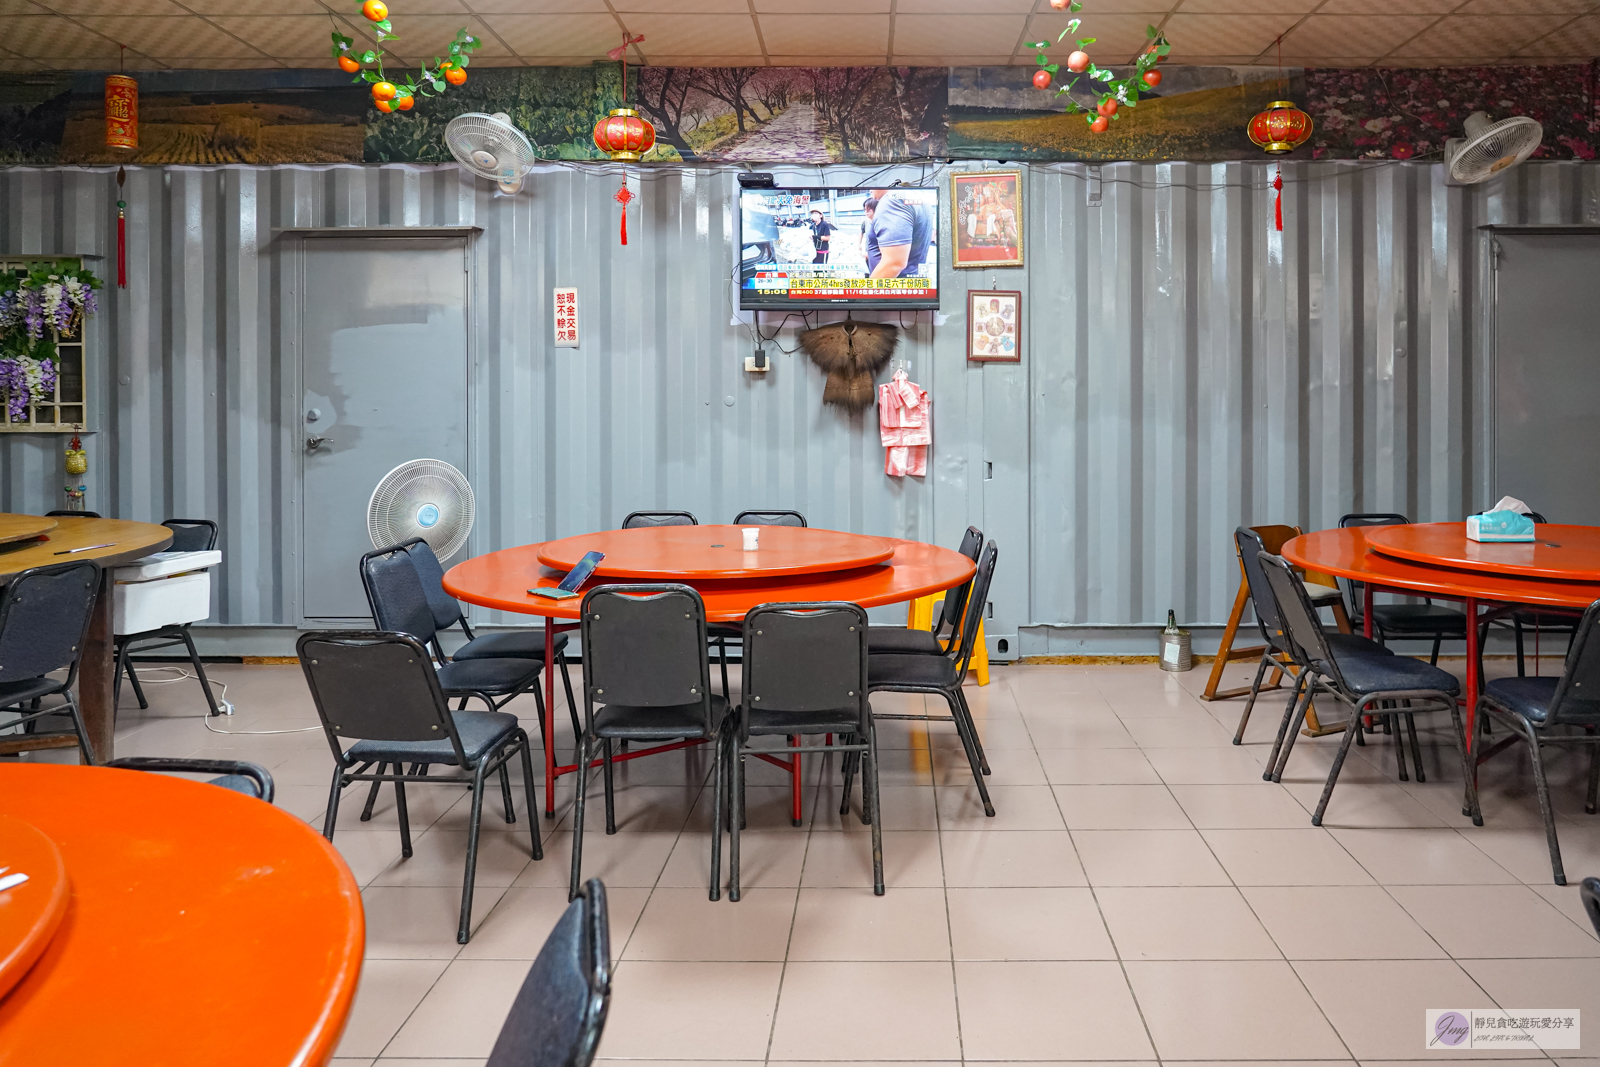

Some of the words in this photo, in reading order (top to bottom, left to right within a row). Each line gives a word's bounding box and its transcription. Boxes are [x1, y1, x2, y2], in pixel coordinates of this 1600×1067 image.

[557, 293, 567, 341] 恕不賒欠
[566, 292, 576, 341] 現金交易
